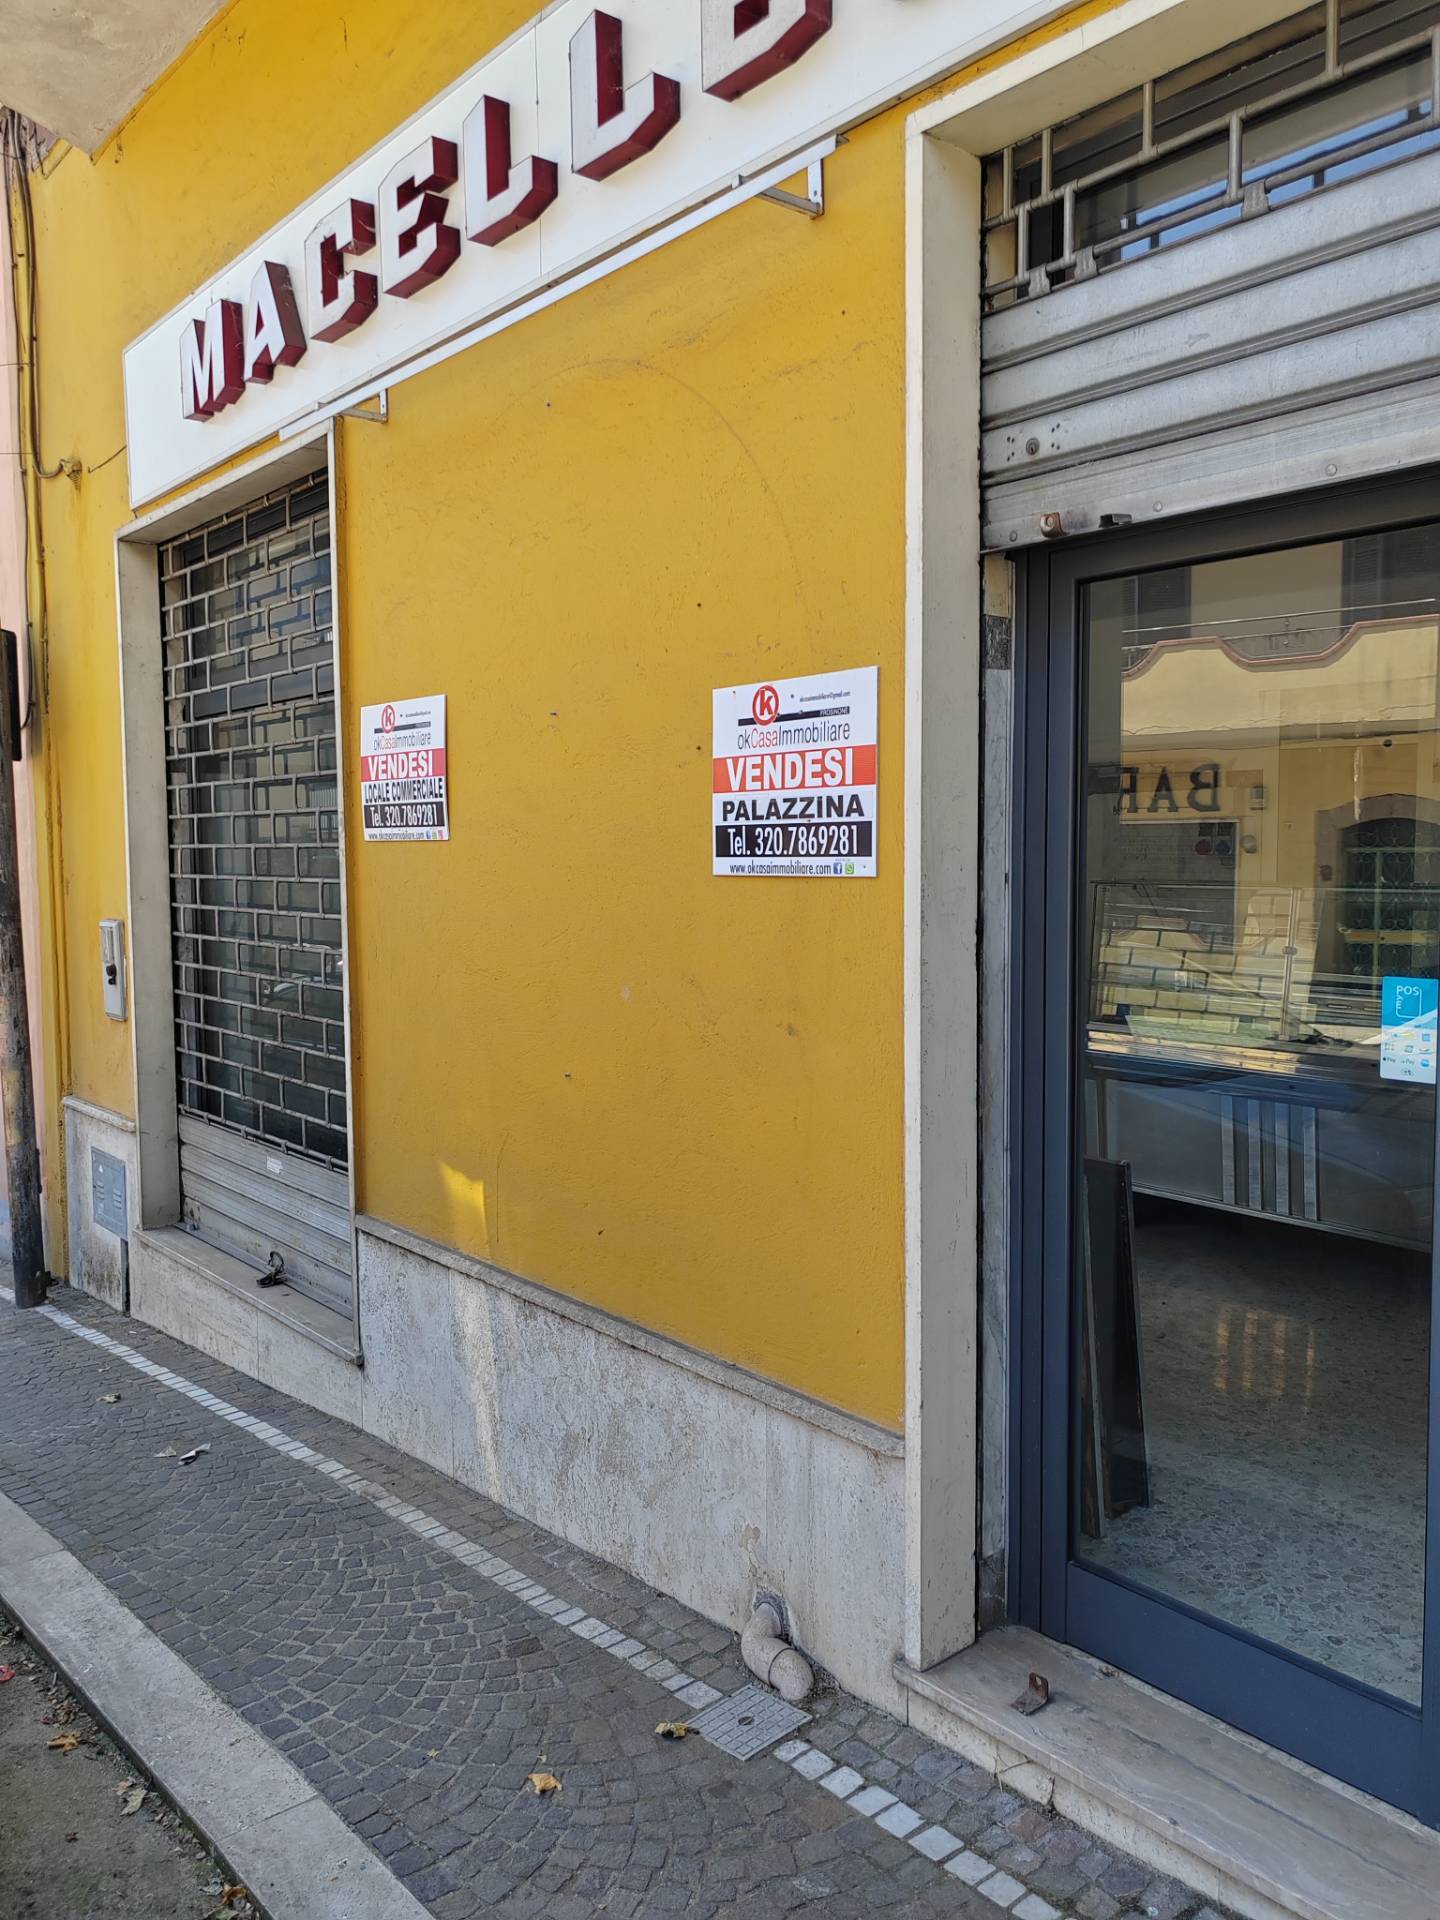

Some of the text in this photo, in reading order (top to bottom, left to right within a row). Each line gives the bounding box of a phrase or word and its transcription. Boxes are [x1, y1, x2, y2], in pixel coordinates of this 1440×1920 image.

[737, 722, 851, 750] okCasaImmobiliare
[368, 750, 433, 781] VENDESI
[726, 748, 854, 791] VENDESI
[364, 777, 443, 804] LOCALE COMMERCIALE
[370, 804, 438, 827] Tel. 320.7869281
[722, 794, 865, 822] PALAZZINA
[727, 825, 858, 856] Tel. 320.7869281
[729, 860, 832, 875] www.okcasaimmobiliare.com
